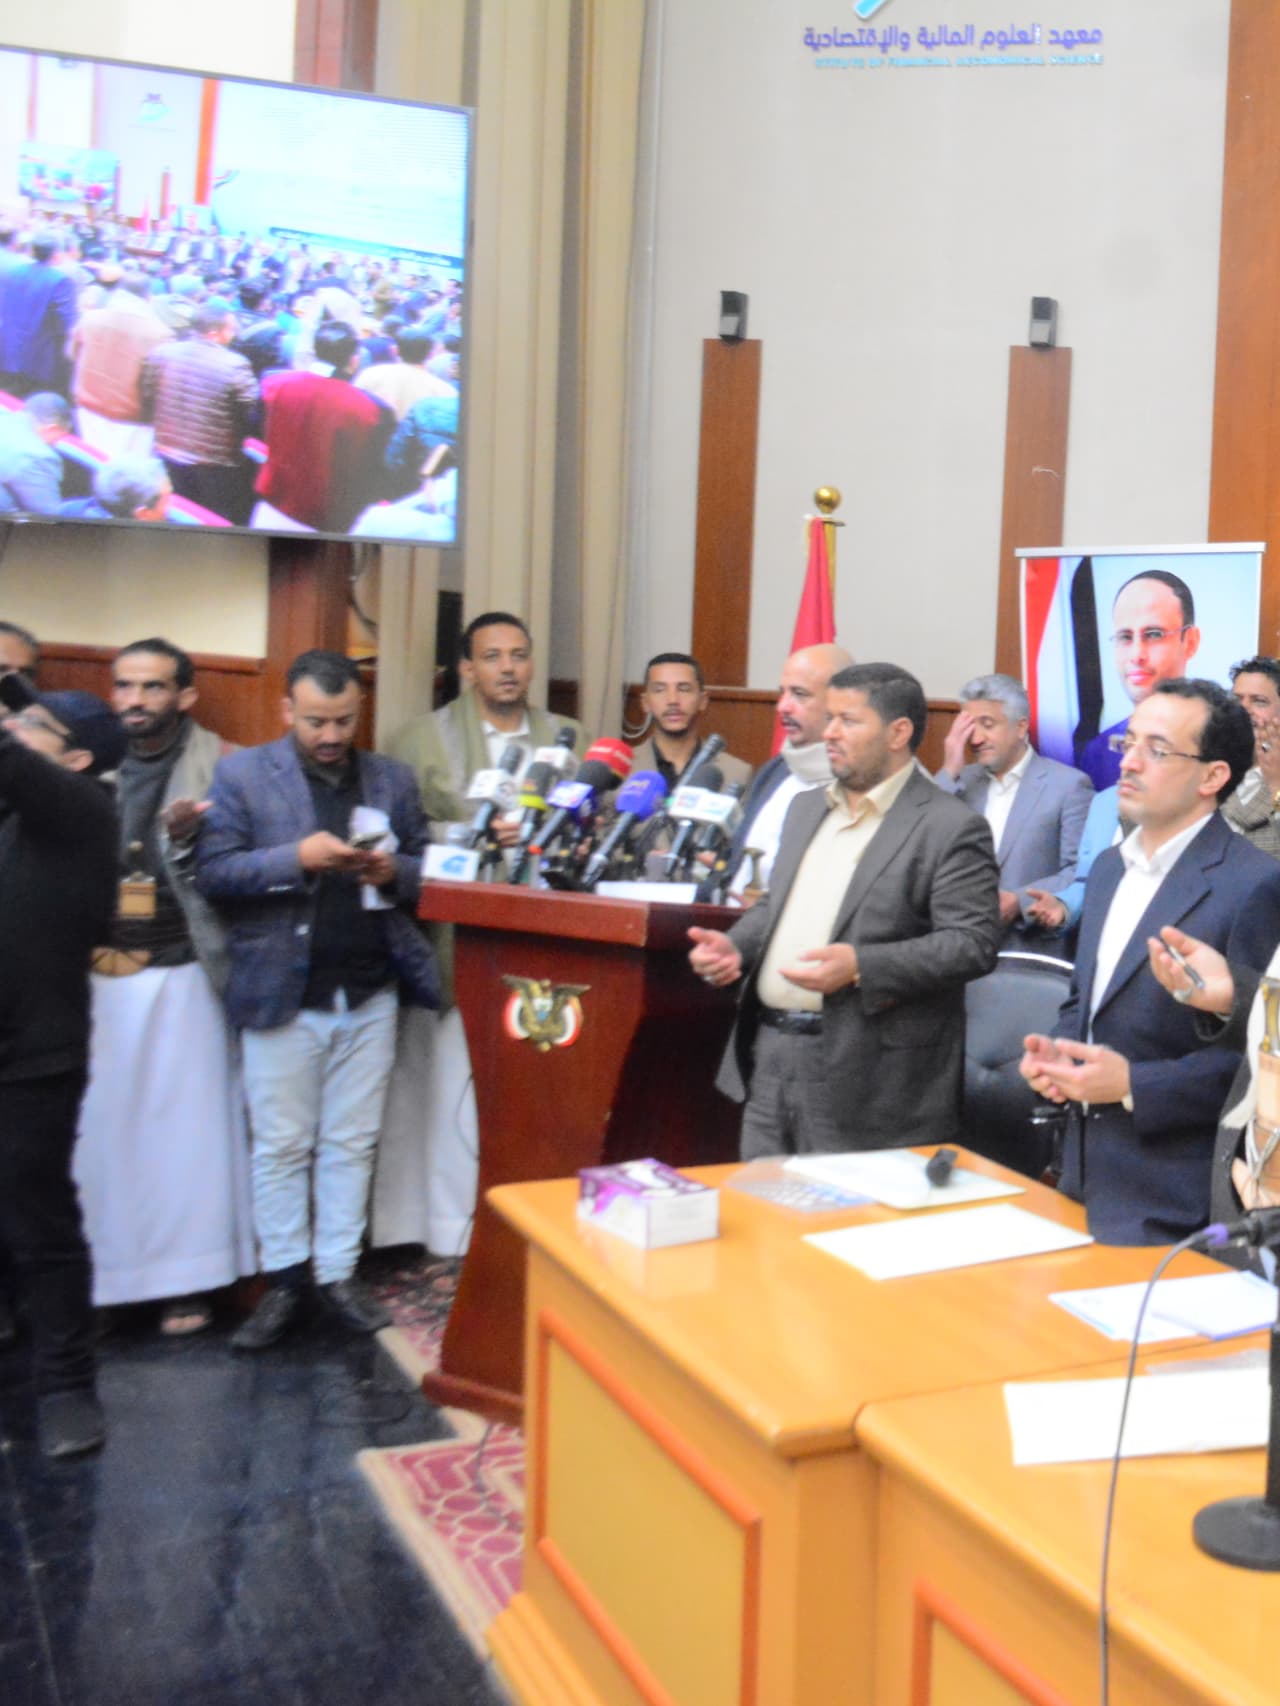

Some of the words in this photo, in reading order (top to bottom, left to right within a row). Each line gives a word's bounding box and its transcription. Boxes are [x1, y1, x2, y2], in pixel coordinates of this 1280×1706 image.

[916, 24, 974, 50] المالية
[980, 24, 1041, 51] العلوم
[1048, 27, 1102, 50] معهد
